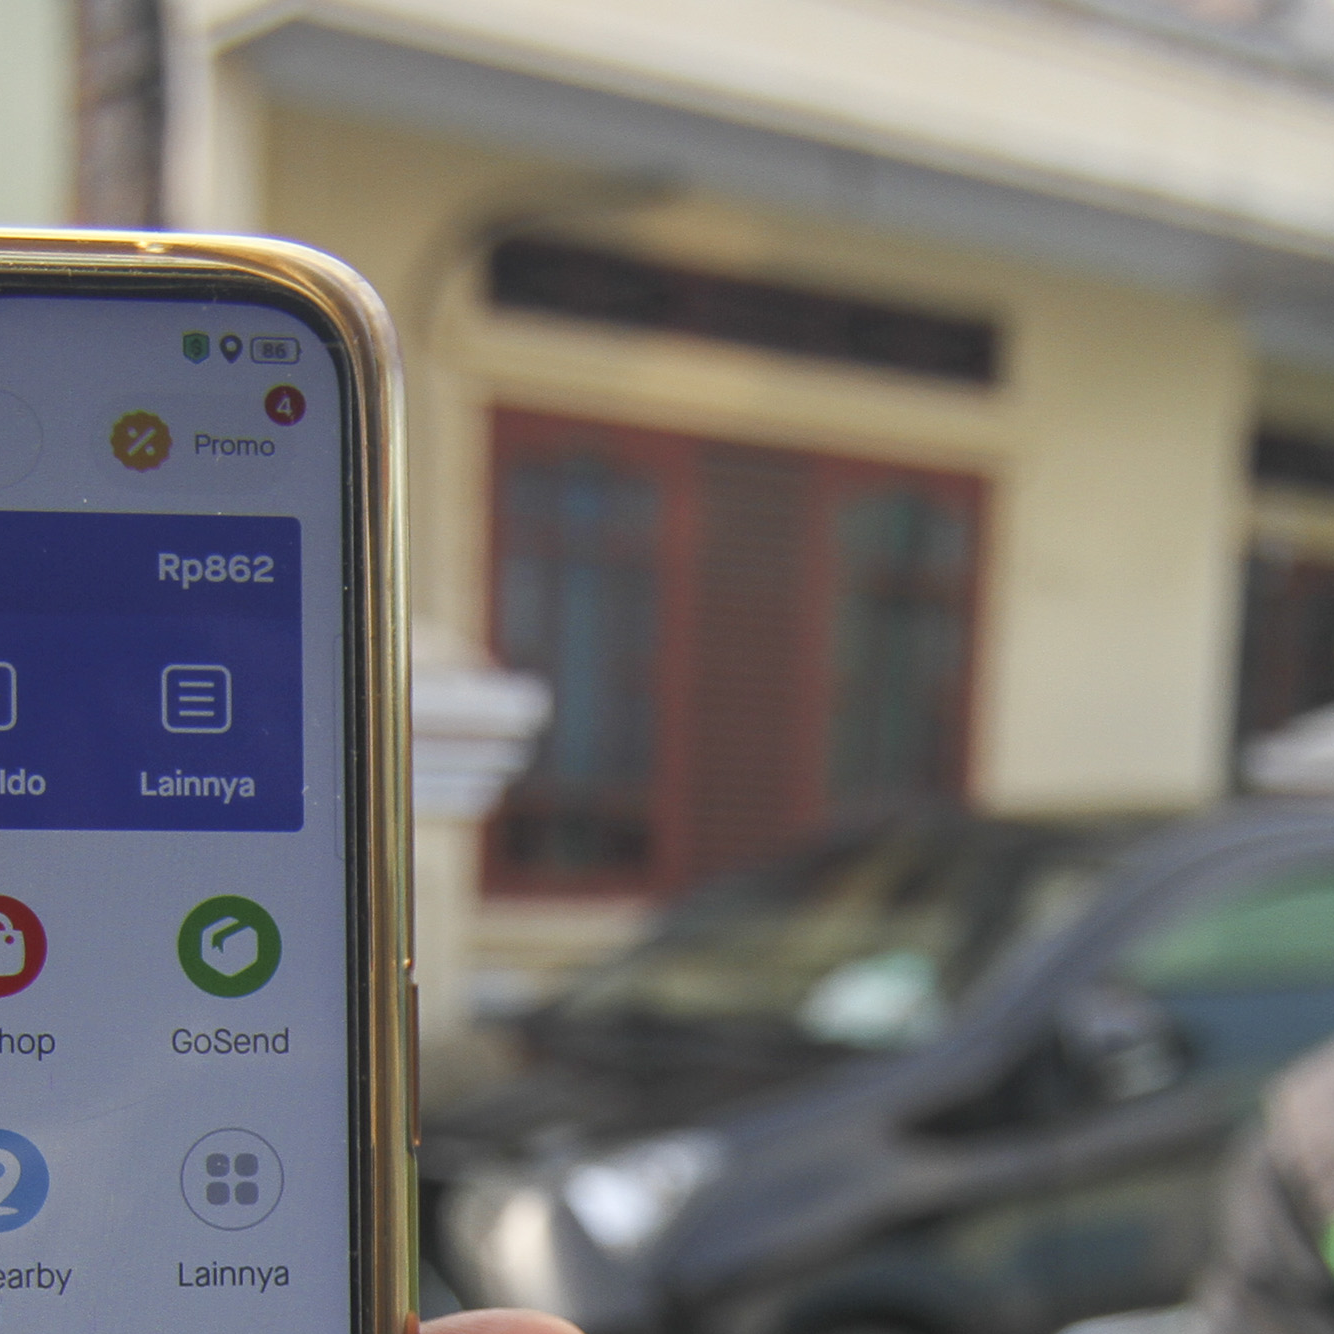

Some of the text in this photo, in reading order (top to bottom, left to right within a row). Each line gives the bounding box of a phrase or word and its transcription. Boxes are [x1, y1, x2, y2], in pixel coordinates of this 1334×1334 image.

[262, 341, 288, 359] 86
[277, 396, 292, 417] 4
[194, 434, 275, 457] Promo
[159, 553, 274, 587] Rp862
[141, 770, 255, 803] Lainnya
[172, 1028, 290, 1055] GoSend
[178, 1259, 289, 1293] Lainnya
